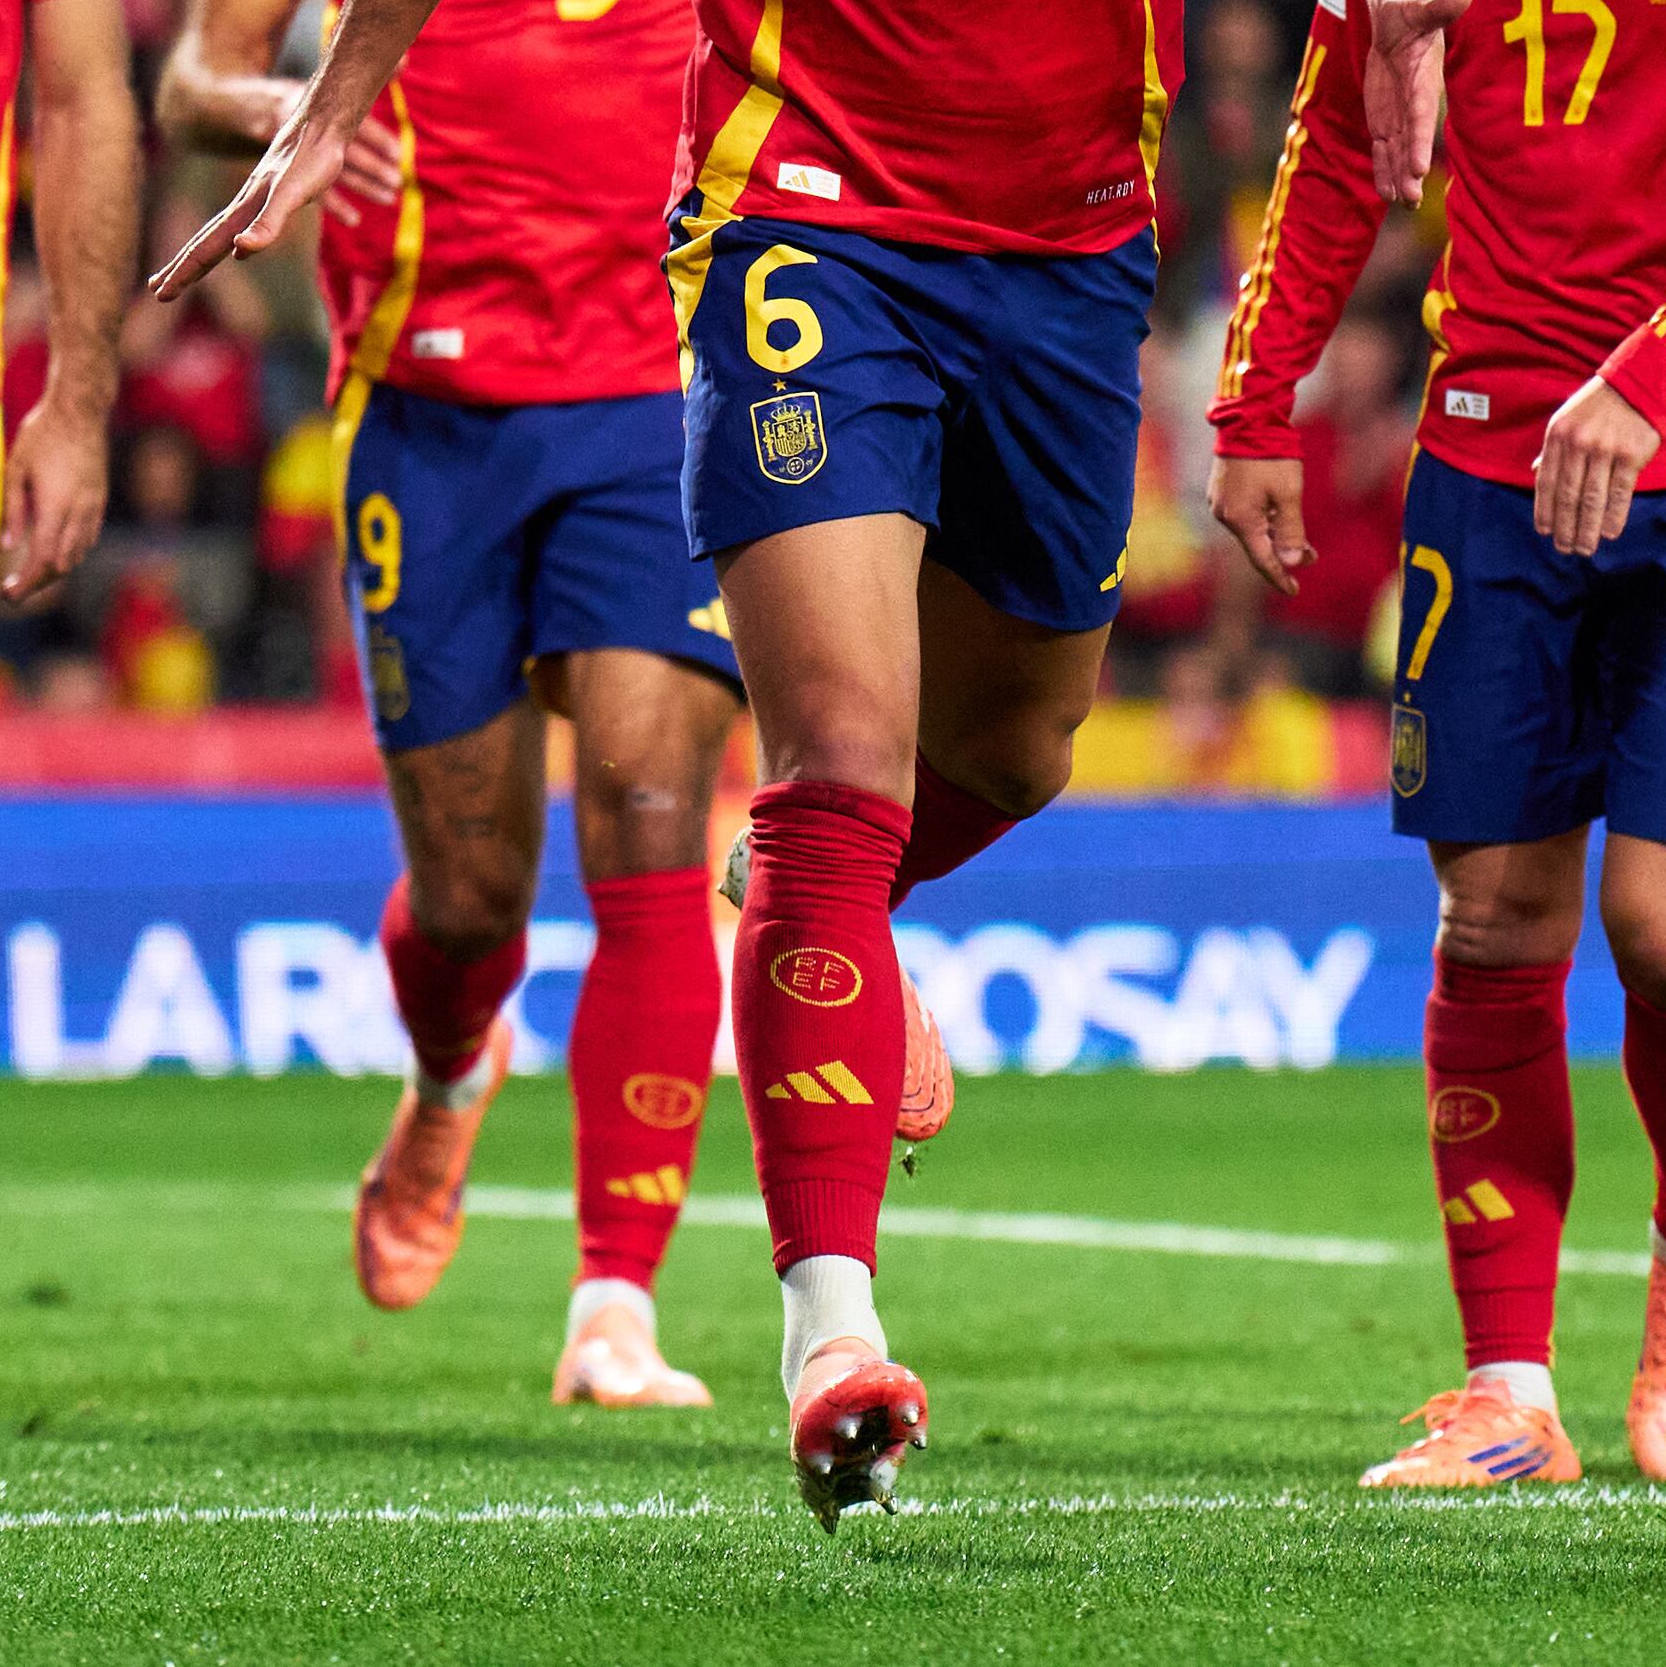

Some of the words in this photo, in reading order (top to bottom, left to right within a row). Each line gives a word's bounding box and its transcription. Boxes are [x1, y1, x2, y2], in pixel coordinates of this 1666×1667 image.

[1086, 179, 1135, 205] HEAT.RDY
[744, 243, 824, 374] 6
[357, 491, 402, 614] 9
[1399, 542, 1453, 680] 7
[9, 921, 235, 1078] LA
